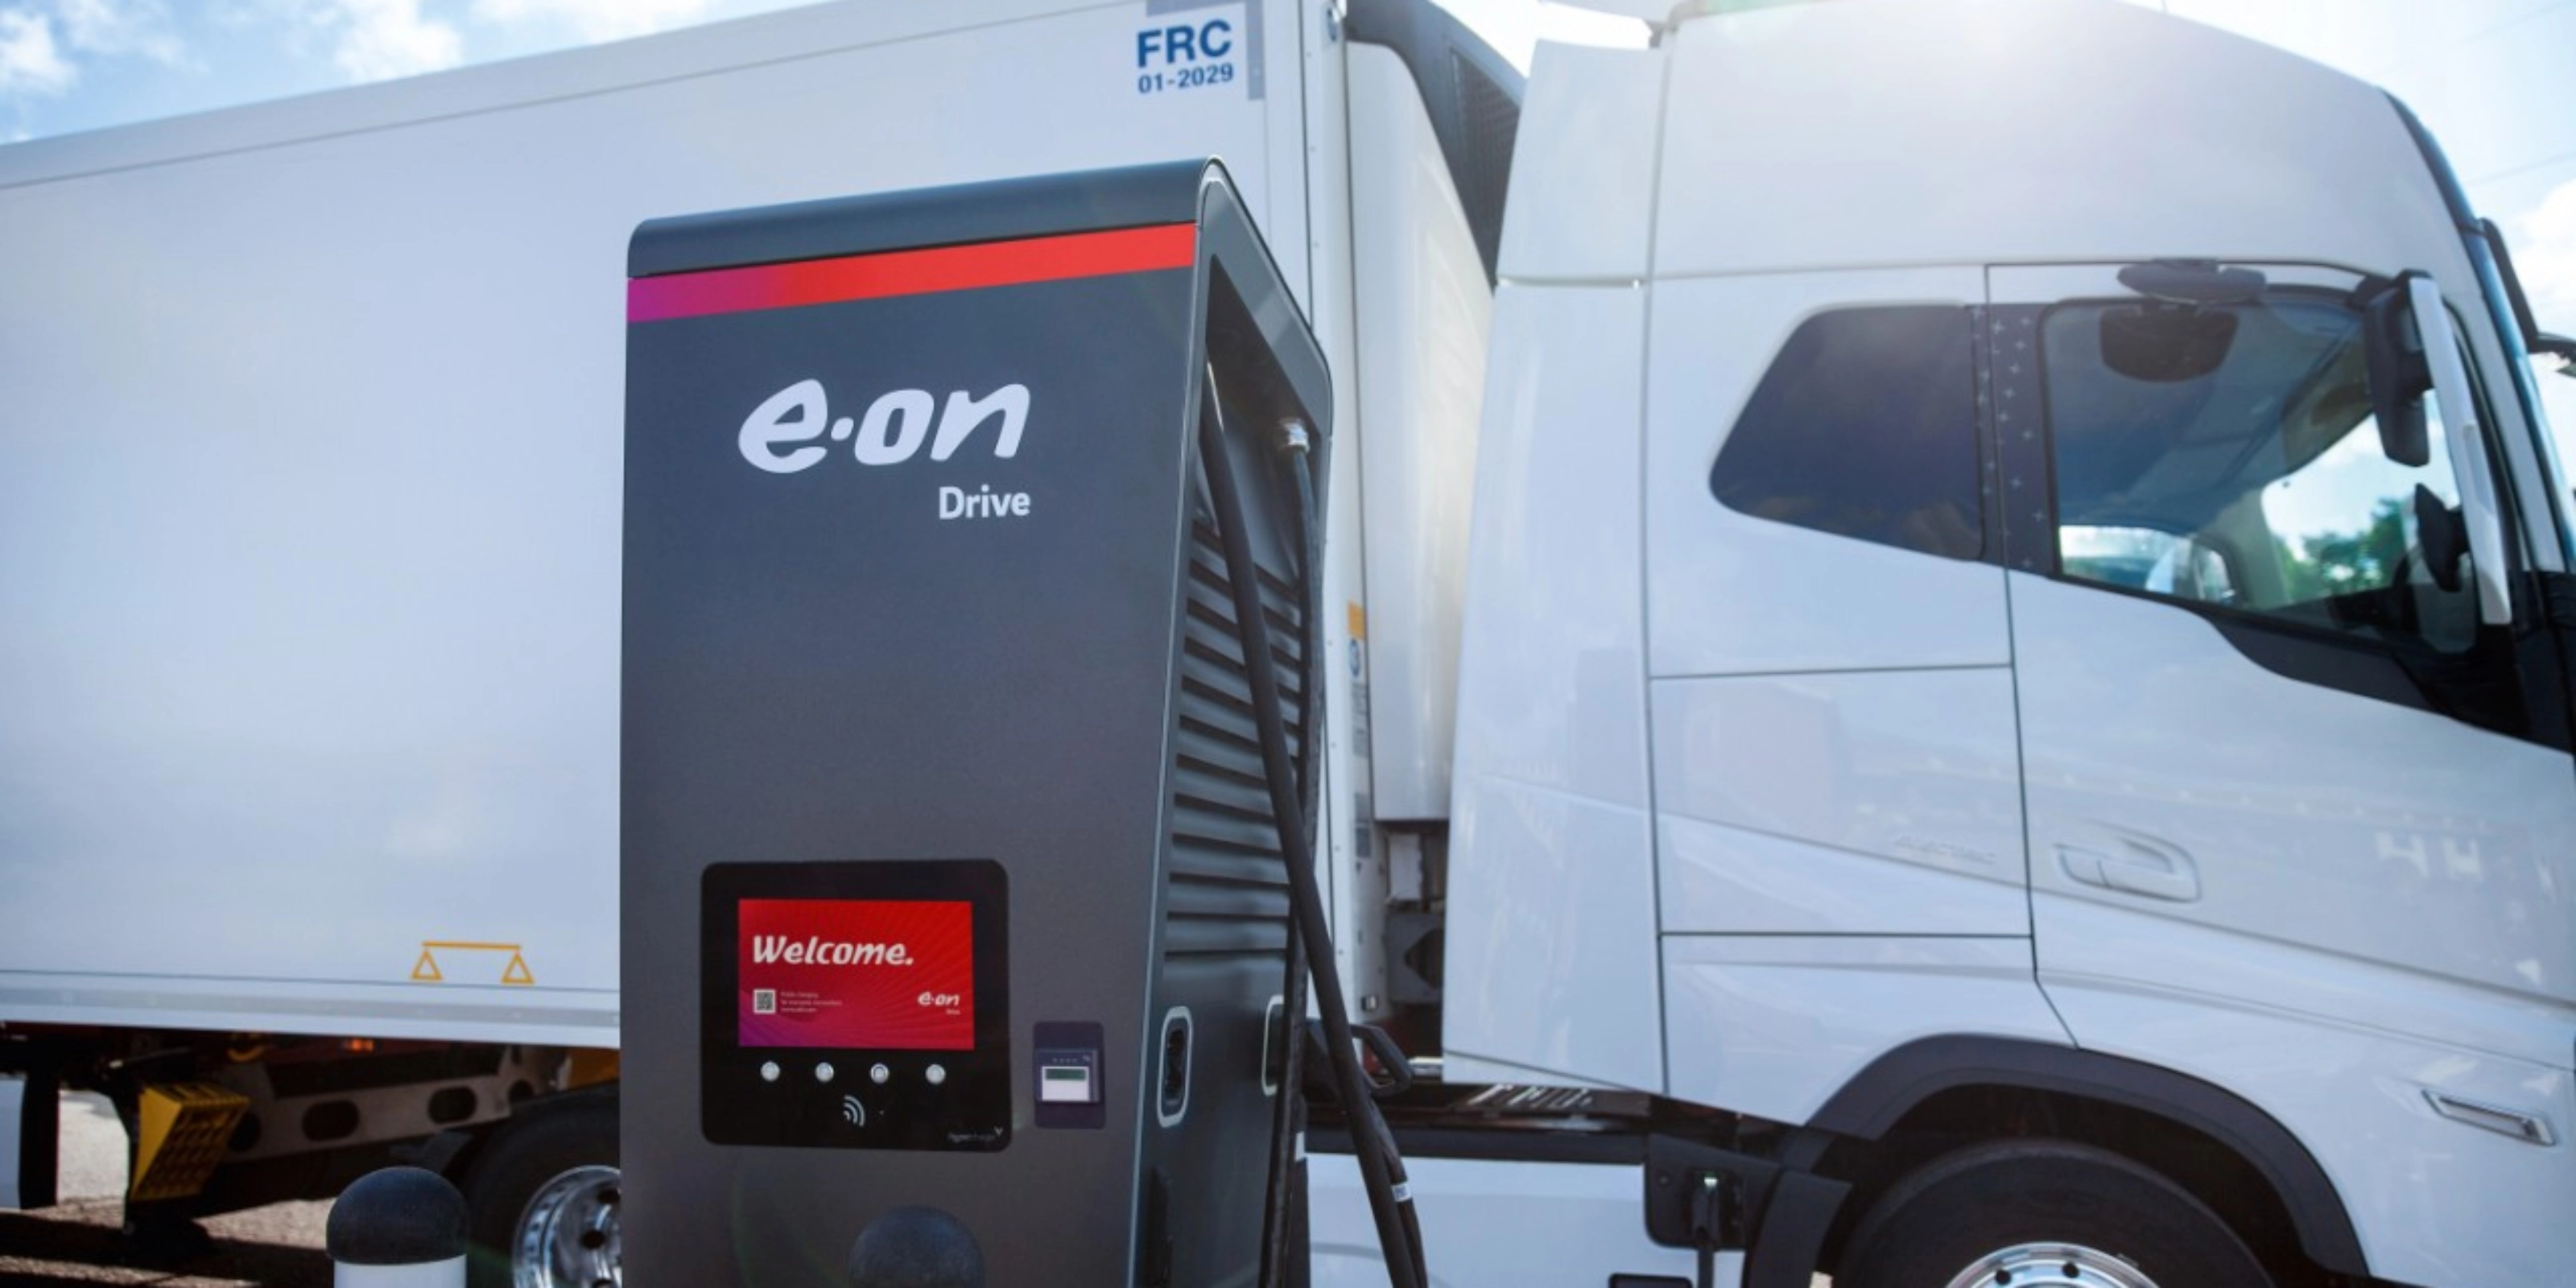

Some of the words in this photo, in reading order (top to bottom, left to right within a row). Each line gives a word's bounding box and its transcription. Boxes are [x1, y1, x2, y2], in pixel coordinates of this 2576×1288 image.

[1137, 19, 1232, 68] FRC
[1137, 62, 1234, 93] 01-2029
[938, 483, 1031, 520] Drive
[753, 935, 914, 966] Welcome.
